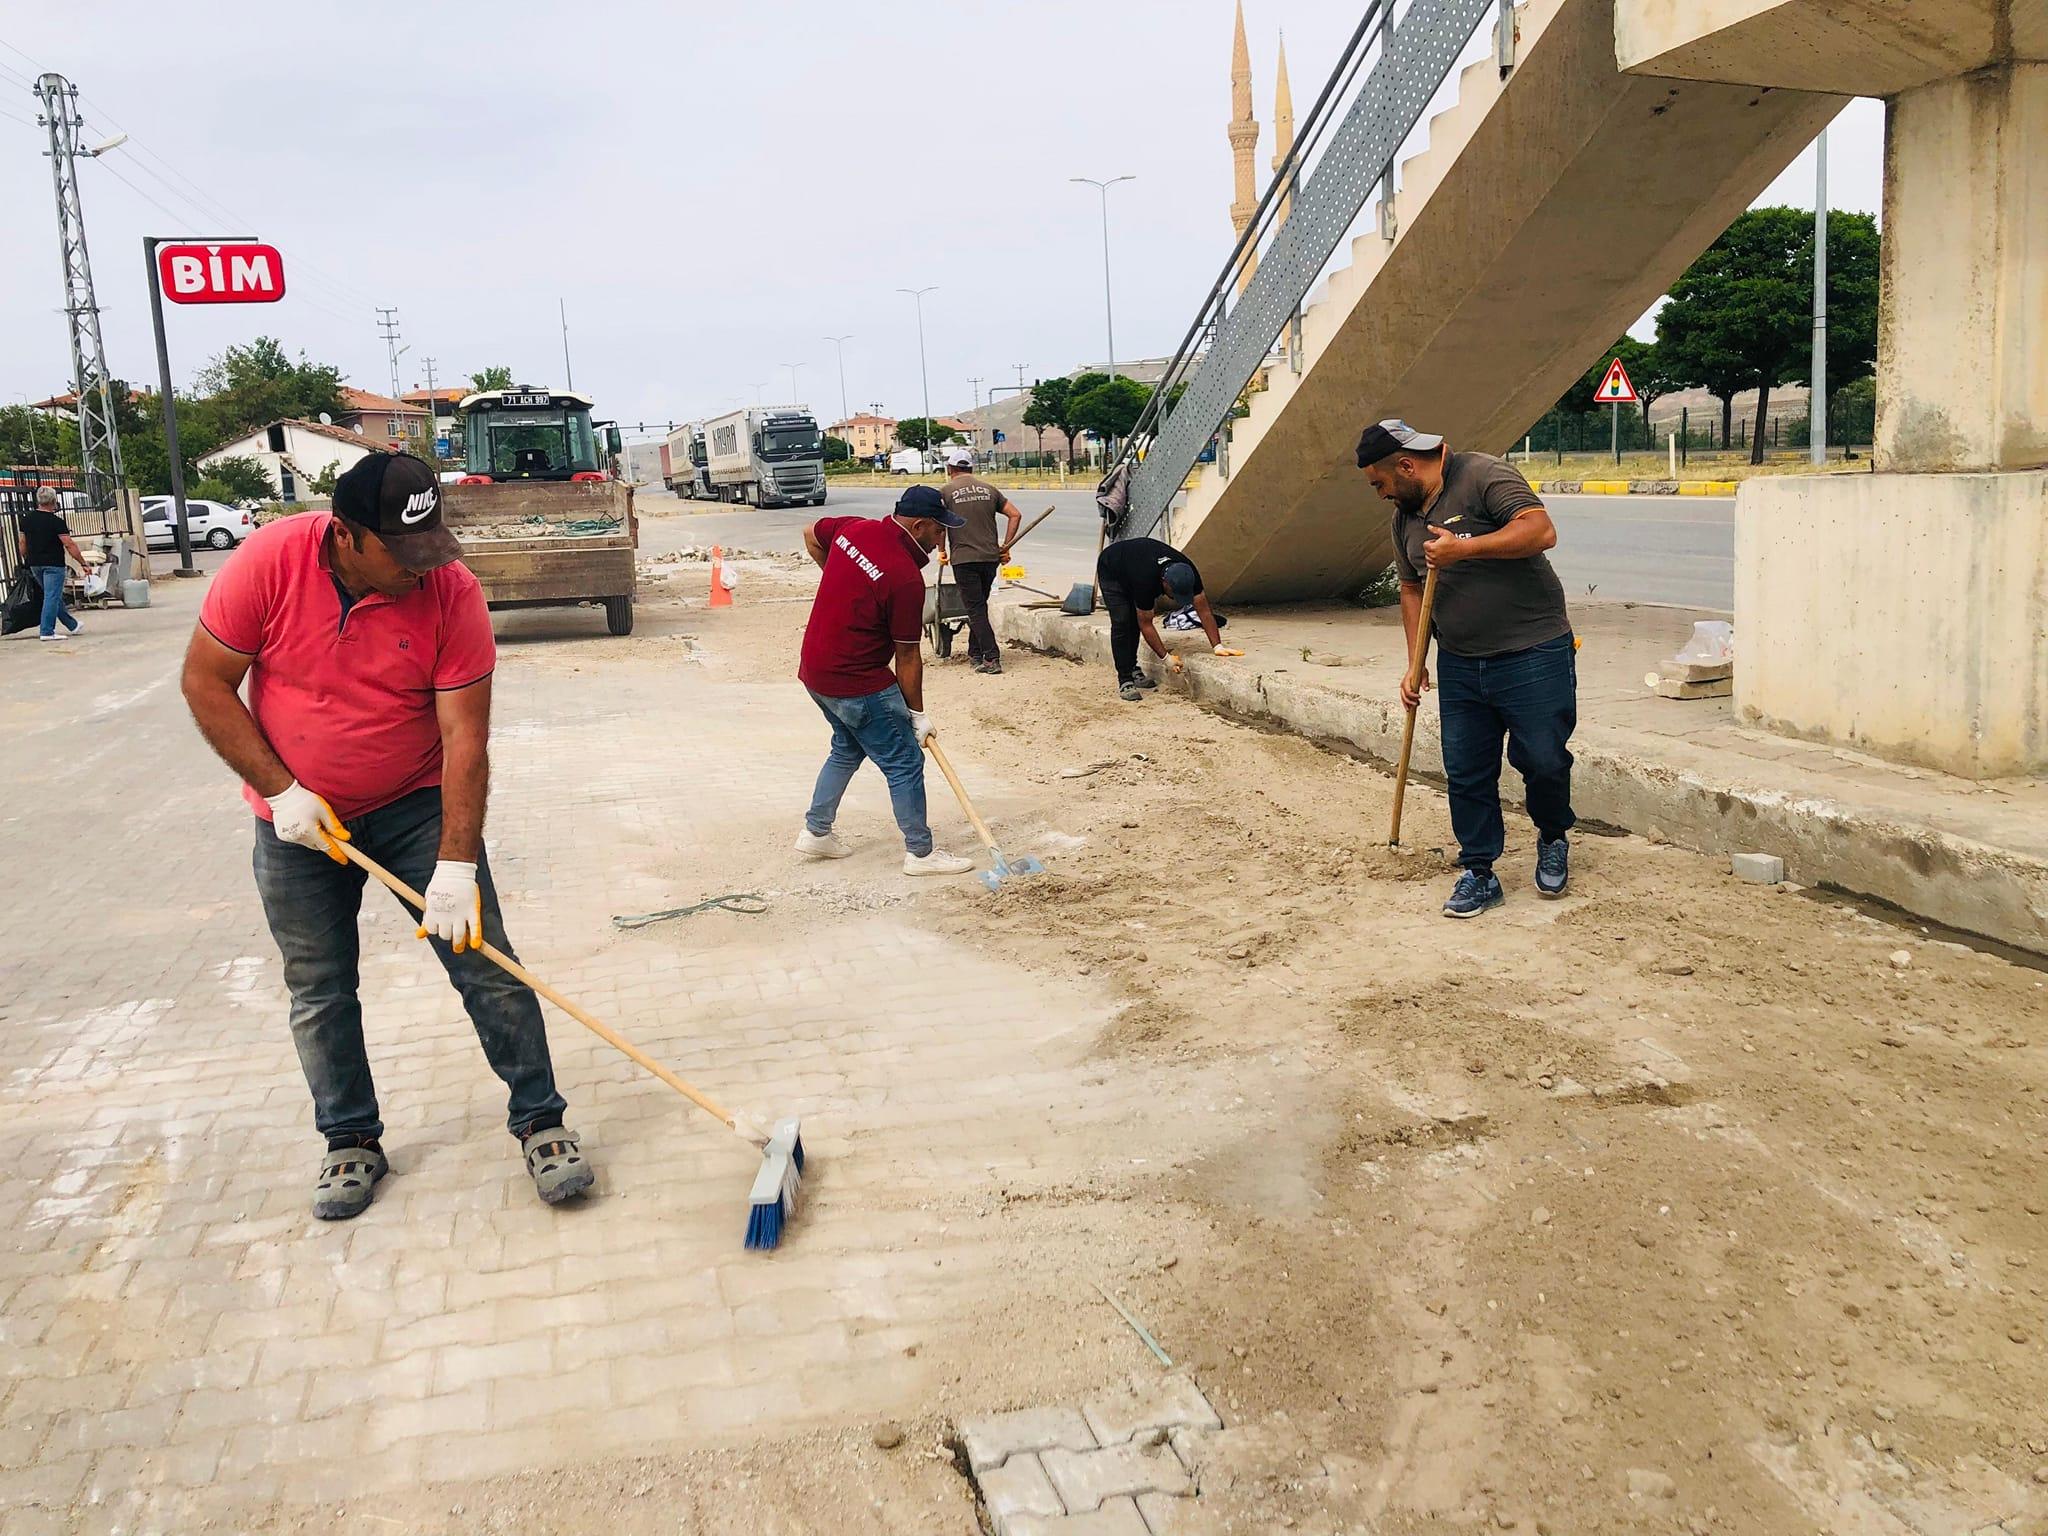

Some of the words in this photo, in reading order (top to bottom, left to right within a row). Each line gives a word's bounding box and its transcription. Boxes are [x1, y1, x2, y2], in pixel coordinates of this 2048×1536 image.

[171, 246, 274, 294] BİM
[508, 395, 516, 404] 71
[406, 486, 434, 512] NIKE
[846, 545, 860, 559] SU
